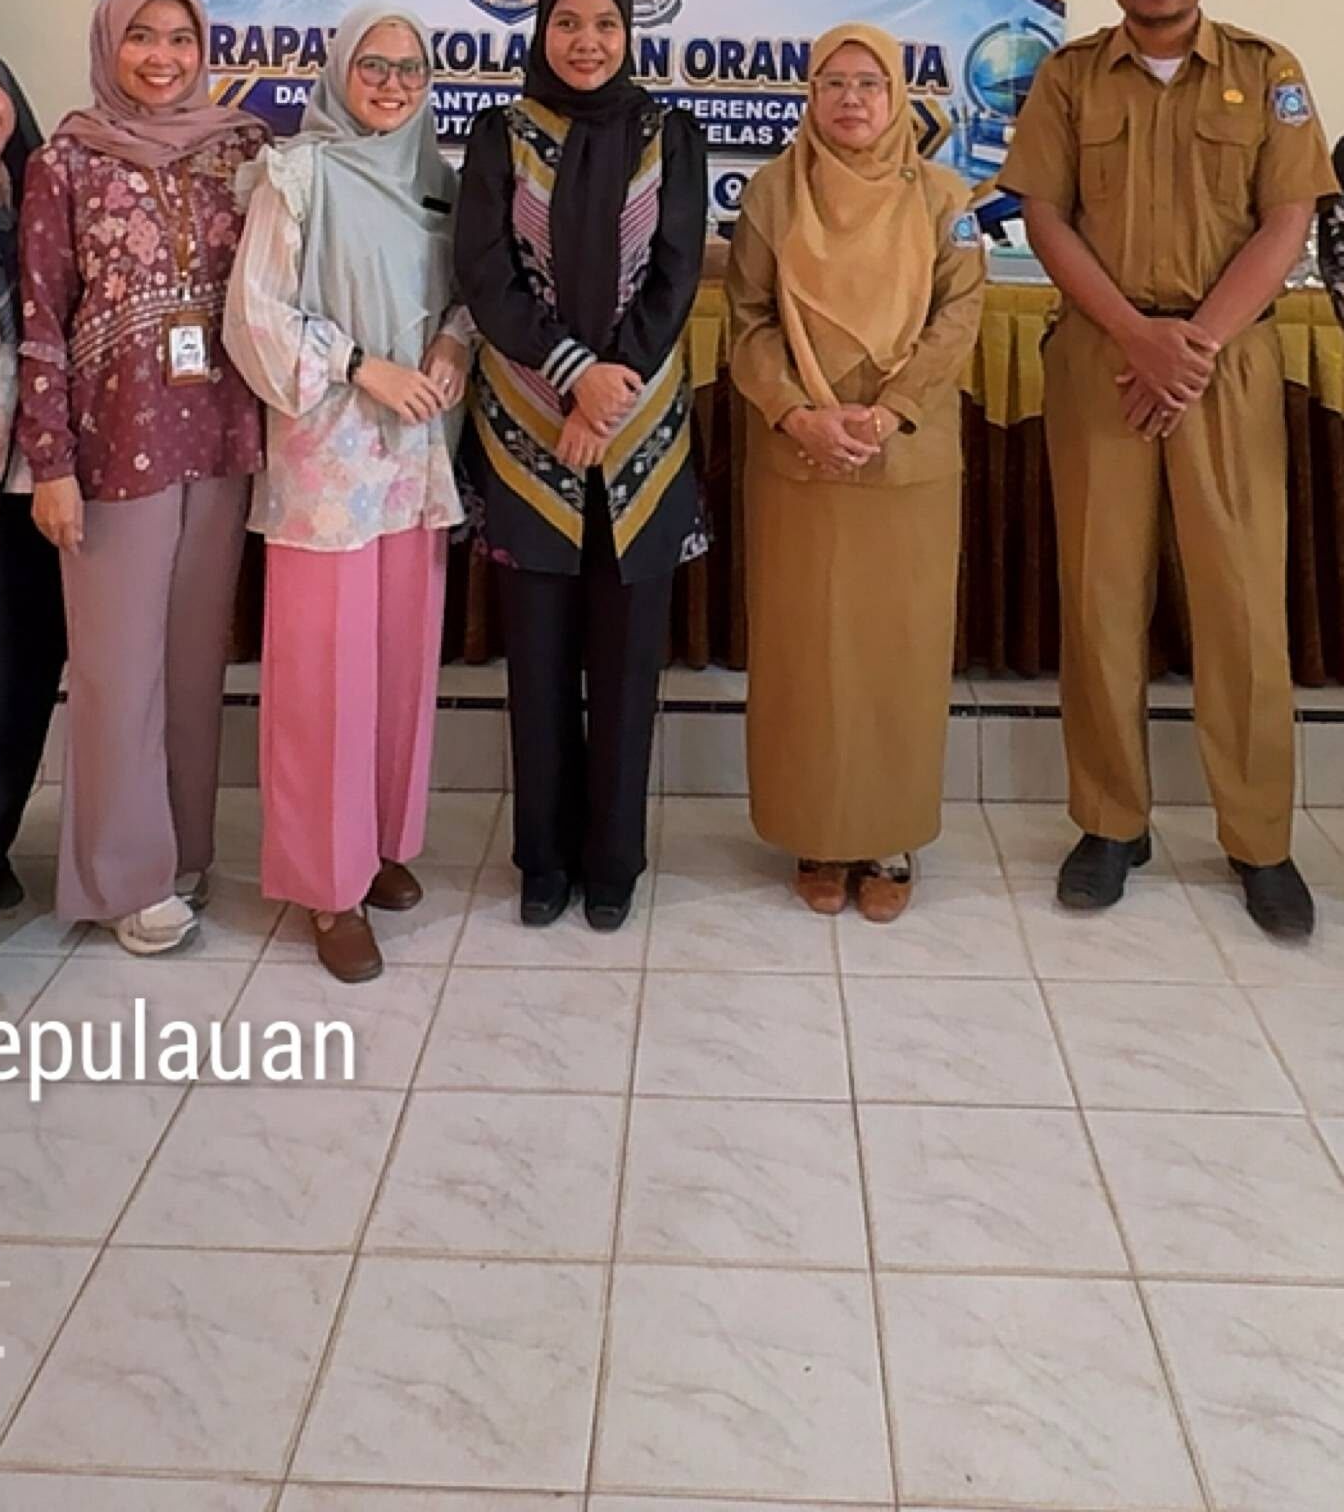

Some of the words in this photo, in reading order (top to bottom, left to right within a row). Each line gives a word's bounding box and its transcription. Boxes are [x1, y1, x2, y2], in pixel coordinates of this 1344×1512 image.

[209, 24, 337, 68] RAPA
[431, 30, 529, 73] KOLA
[683, 36, 811, 83] ORAN
[677, 97, 808, 121] PERENCA
[699, 122, 773, 146] ELAS
